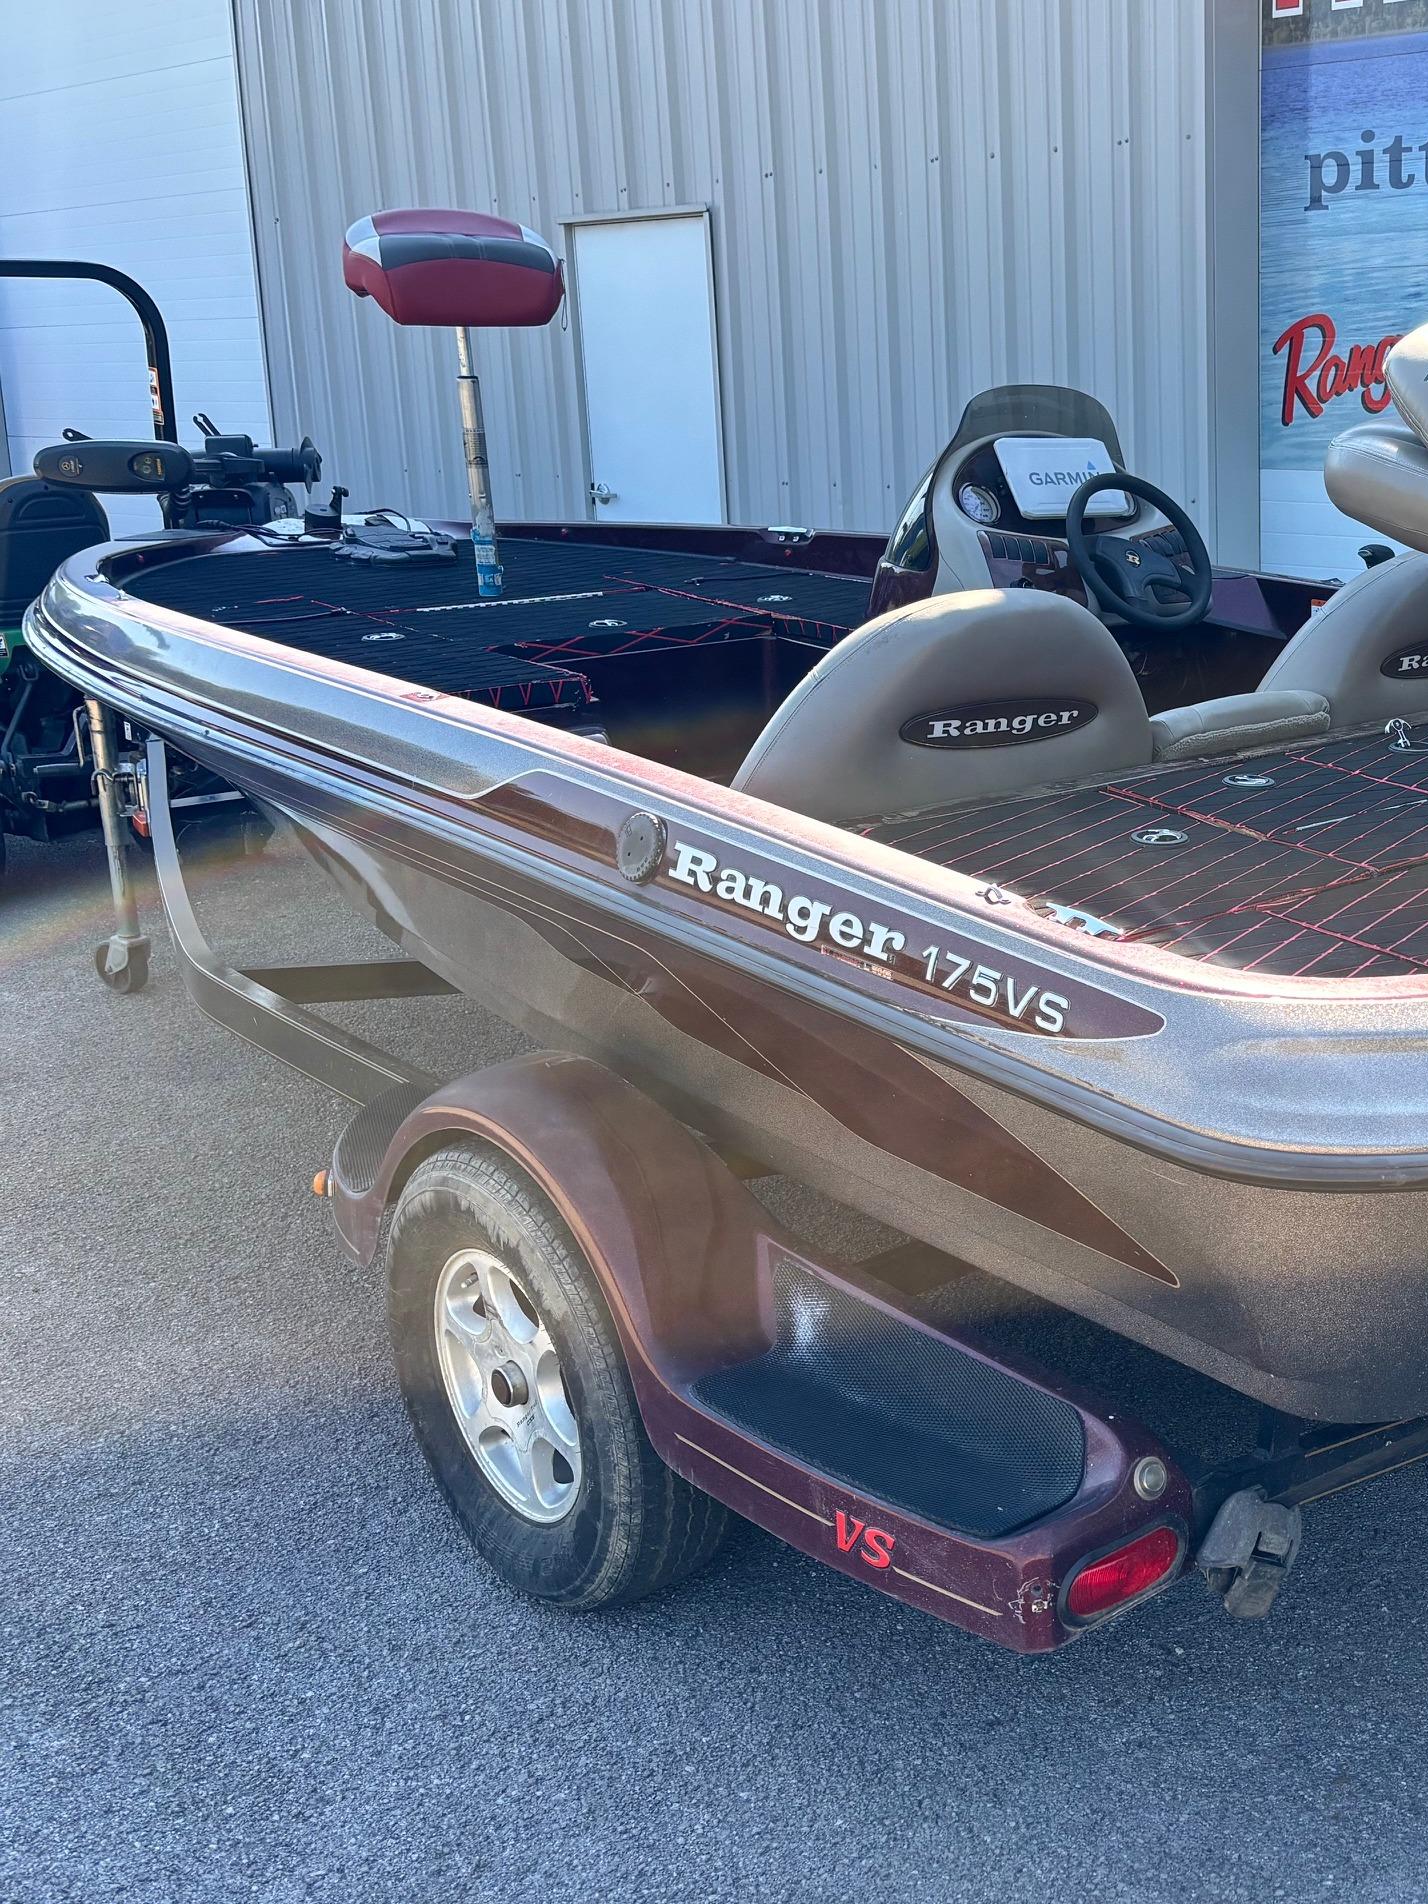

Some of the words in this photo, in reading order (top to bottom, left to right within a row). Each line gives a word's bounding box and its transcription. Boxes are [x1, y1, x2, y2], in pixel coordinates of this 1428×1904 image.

[1272, 313, 1401, 426] Rang
[926, 709, 1079, 739] Ranger
[667, 839, 907, 965] Ranger
[922, 944, 1072, 1035] 175VS
[835, 1508, 896, 1569] VS
